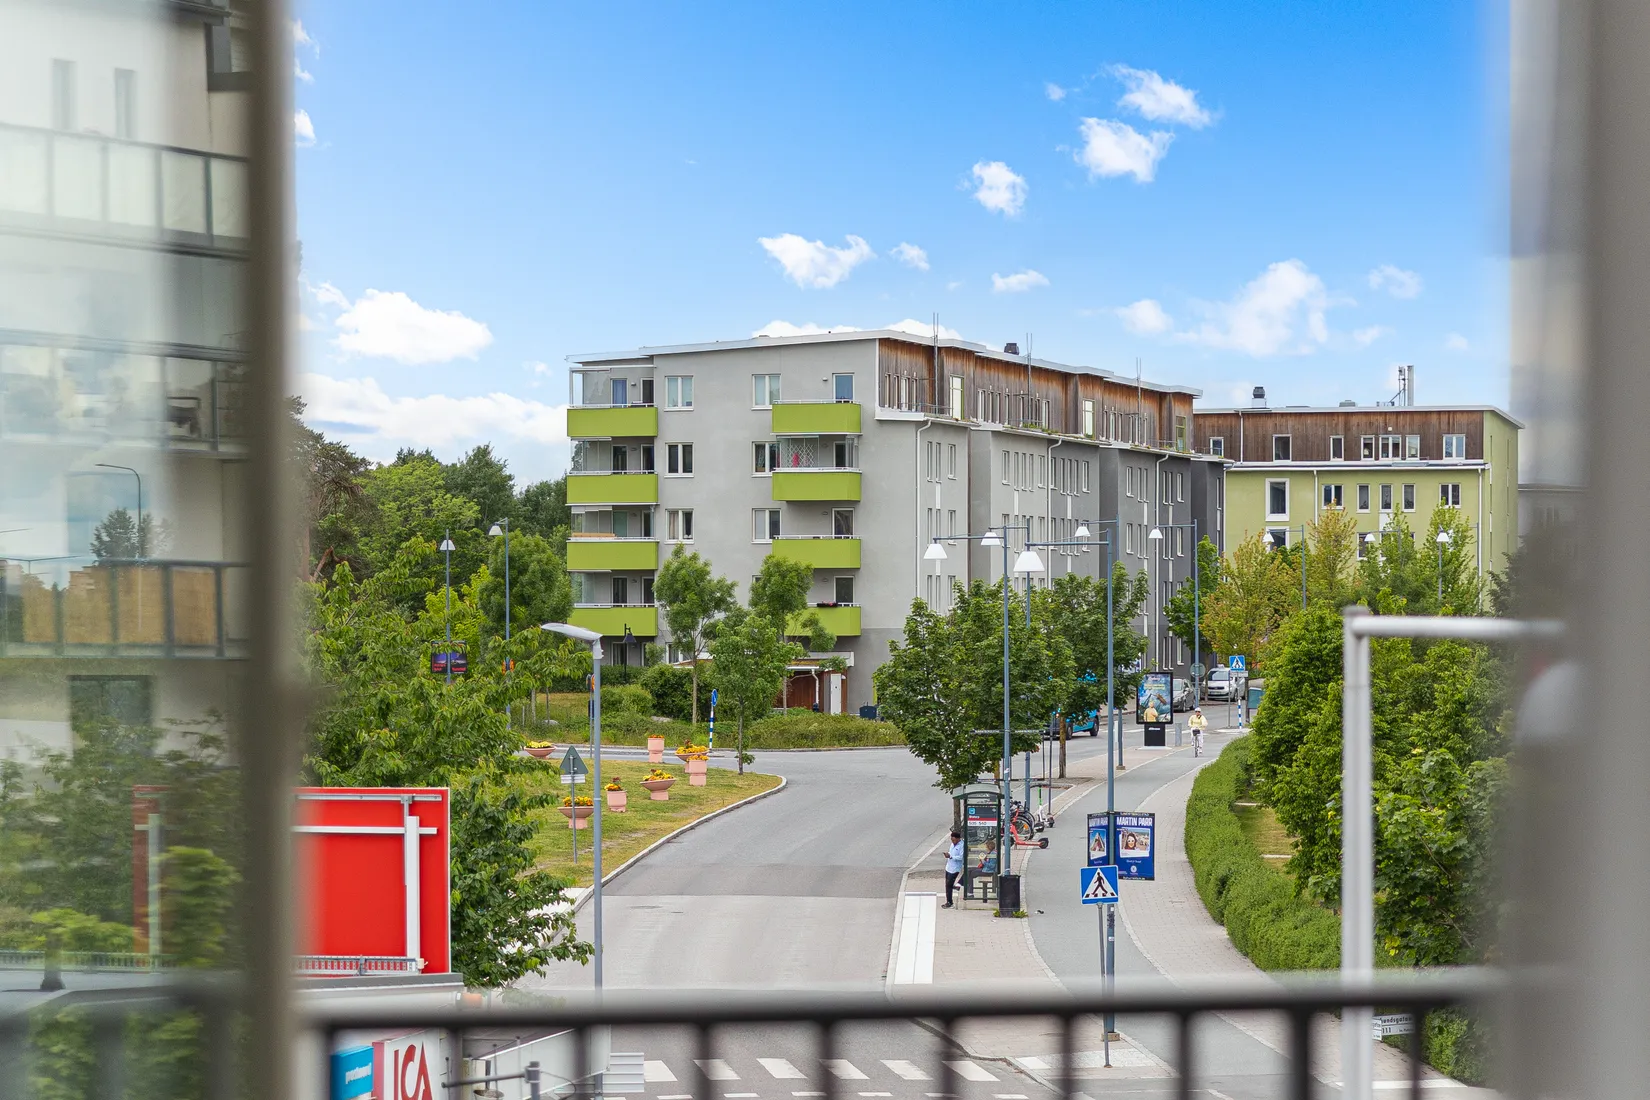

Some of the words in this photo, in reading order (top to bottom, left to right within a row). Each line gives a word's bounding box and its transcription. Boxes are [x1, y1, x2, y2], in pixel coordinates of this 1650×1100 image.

[1116, 817, 1138, 826] MARTIN
[1138, 817, 1153, 826] PARR
[393, 1041, 433, 1100] ICA
